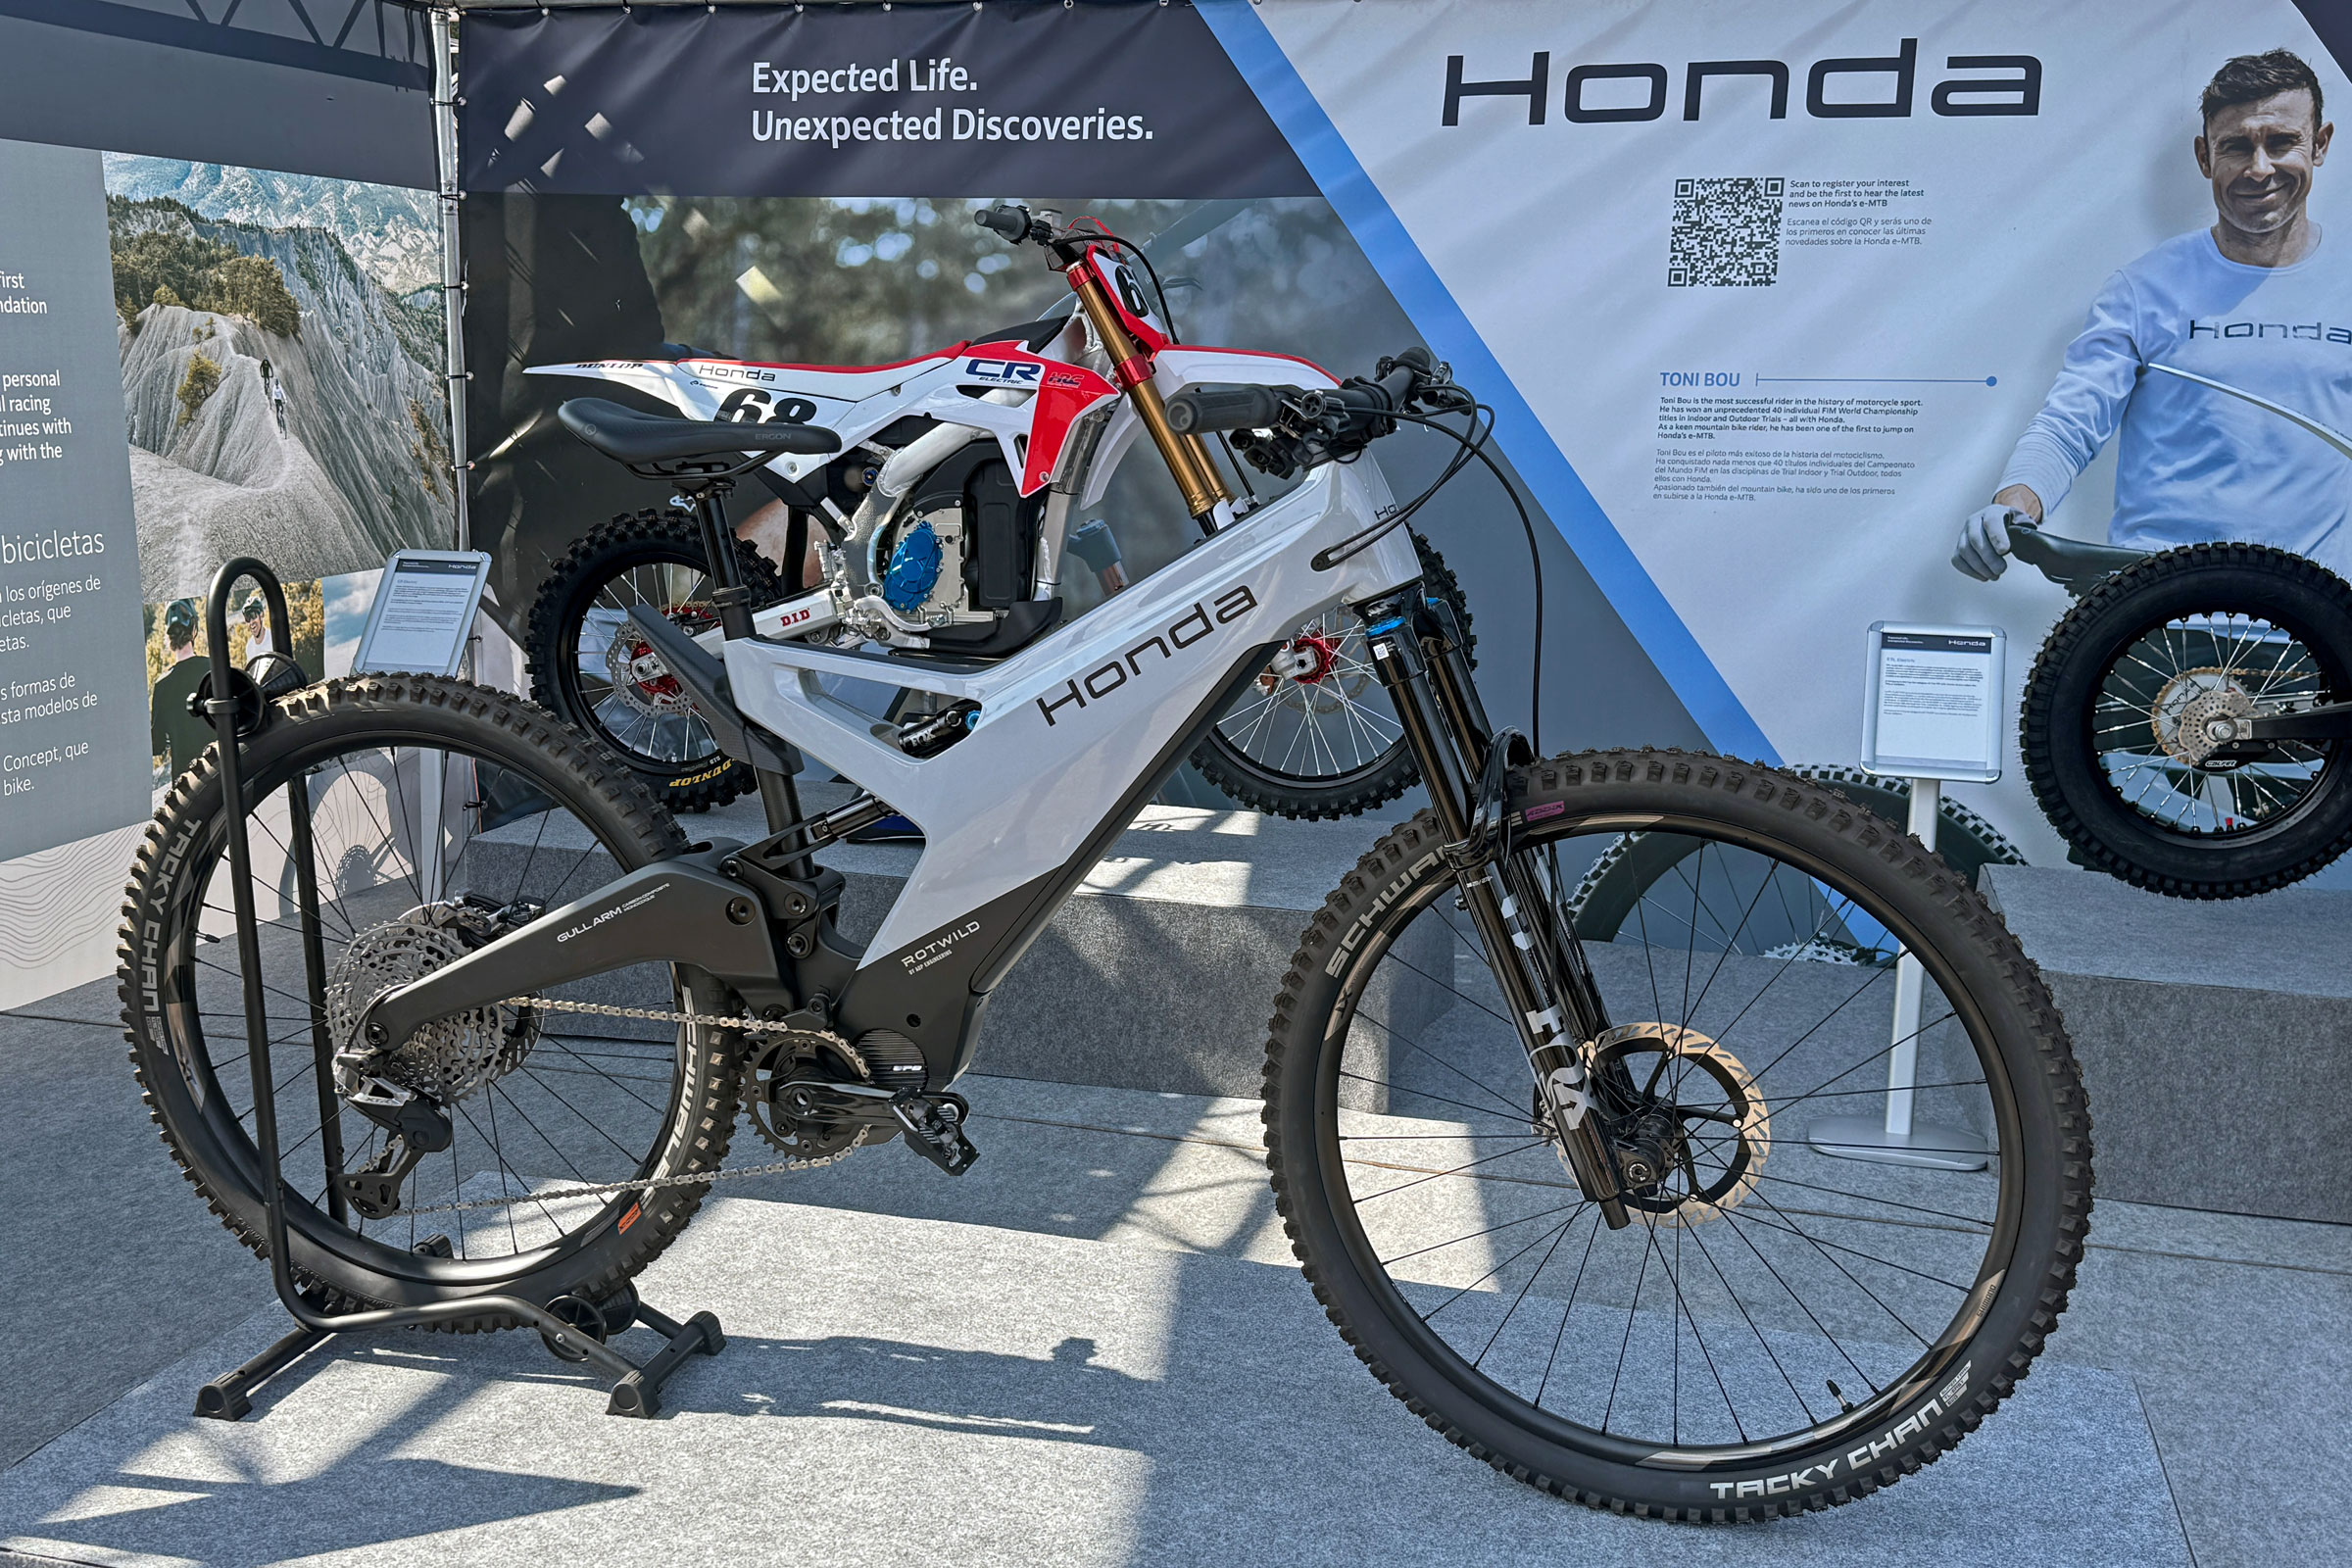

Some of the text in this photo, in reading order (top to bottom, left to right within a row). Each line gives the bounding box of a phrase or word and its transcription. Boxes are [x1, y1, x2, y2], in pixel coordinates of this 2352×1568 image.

[752, 57, 978, 102] Expected Life.
[1441, 37, 2042, 126] Honda
[752, 107, 1153, 149] Unexpected Discoveries.
[1789, 189, 1805, 198] and
[1806, 189, 1817, 198] be
[1819, 189, 1833, 198] the
[1835, 189, 1851, 198] first
[1853, 189, 1862, 198] to
[1864, 189, 1882, 198] hear
[1790, 179, 1810, 188] Scan
[1822, 179, 1854, 190] register
[1877, 178, 1909, 187] interest
[1824, 199, 1857, 208] Honda's
[1786, 227, 1797, 236] los
[1799, 227, 1835, 238] primeros
[1830, 218, 1858, 227] código
[1921, 217, 1933, 225] de
[1786, 237, 1829, 246] novedades
[1830, 237, 1852, 246] sobre
[1854, 237, 1862, 246] la
[2188, 319, 2352, 345] Honda
[2, 368, 61, 392] personal
[699, 364, 776, 382] Honda
[965, 359, 1042, 382] CR
[978, 376, 1024, 385] ELECTRIC
[1660, 372, 1740, 387] TONI BOU
[9, 394, 52, 416] racing
[713, 388, 817, 424] 68
[1692, 397, 1699, 406] is
[1700, 397, 1713, 406] the
[1714, 397, 1734, 406] most
[1794, 398, 1802, 407] in
[1803, 398, 1817, 407] the
[1818, 398, 1844, 409] history
[1855, 399, 1899, 410] motorcycle
[1714, 406, 1771, 416] unprecedented
[1784, 407, 1820, 416] individual
[1822, 407, 1837, 416] FIM
[1838, 407, 1862, 416] World
[1862, 408, 1918, 417] Championship
[42, 416, 73, 435] with
[1693, 423, 1730, 432] mountain
[1731, 423, 1746, 432] bike
[1780, 424, 1793, 433] has
[1795, 424, 1815, 433] been
[1832, 424, 1840, 433] of
[1882, 425, 1903, 436] jump
[1713, 415, 1727, 423] and
[1729, 415, 1760, 423] Outdoor
[6, 442, 37, 462] with
[40, 441, 63, 460] the
[1, 529, 105, 564] bicicletas
[5, 585, 25, 603] los
[27, 579, 83, 602] orígenes
[85, 573, 102, 592] de
[47, 605, 72, 624] que
[1947, 639, 1986, 648] Honda
[1036, 583, 1258, 728] Honda
[10, 671, 75, 699] formas de
[24, 695, 79, 720] modelos
[81, 690, 98, 709] de
[3, 741, 89, 772] Concept, que
[668, 759, 733, 787] DUNLOP
[3, 776, 35, 797] bike.
[149, 819, 203, 916] TACKY
[901, 920, 980, 967] ROTWILD
[140, 919, 162, 1012] CHAN
[1709, 1397, 1943, 1499] TACKY CHAN
